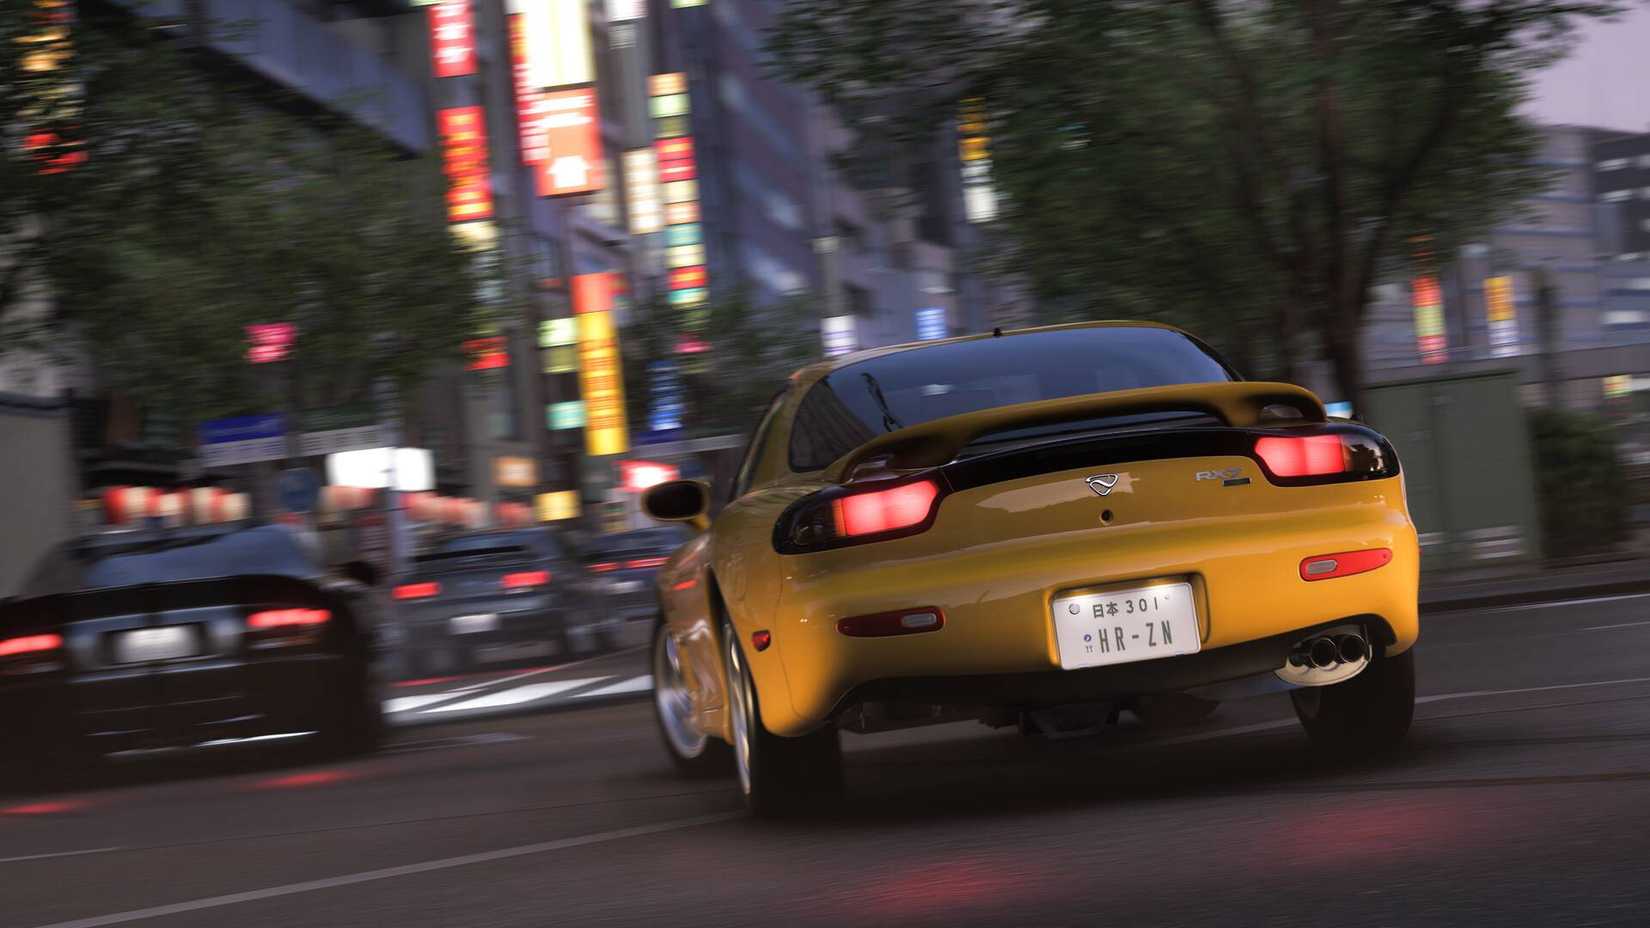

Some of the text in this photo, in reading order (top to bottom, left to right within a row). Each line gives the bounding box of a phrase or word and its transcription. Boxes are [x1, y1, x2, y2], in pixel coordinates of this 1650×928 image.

[1092, 597, 1158, 619] 日本 301
[1098, 620, 1173, 653] HR-ZN
